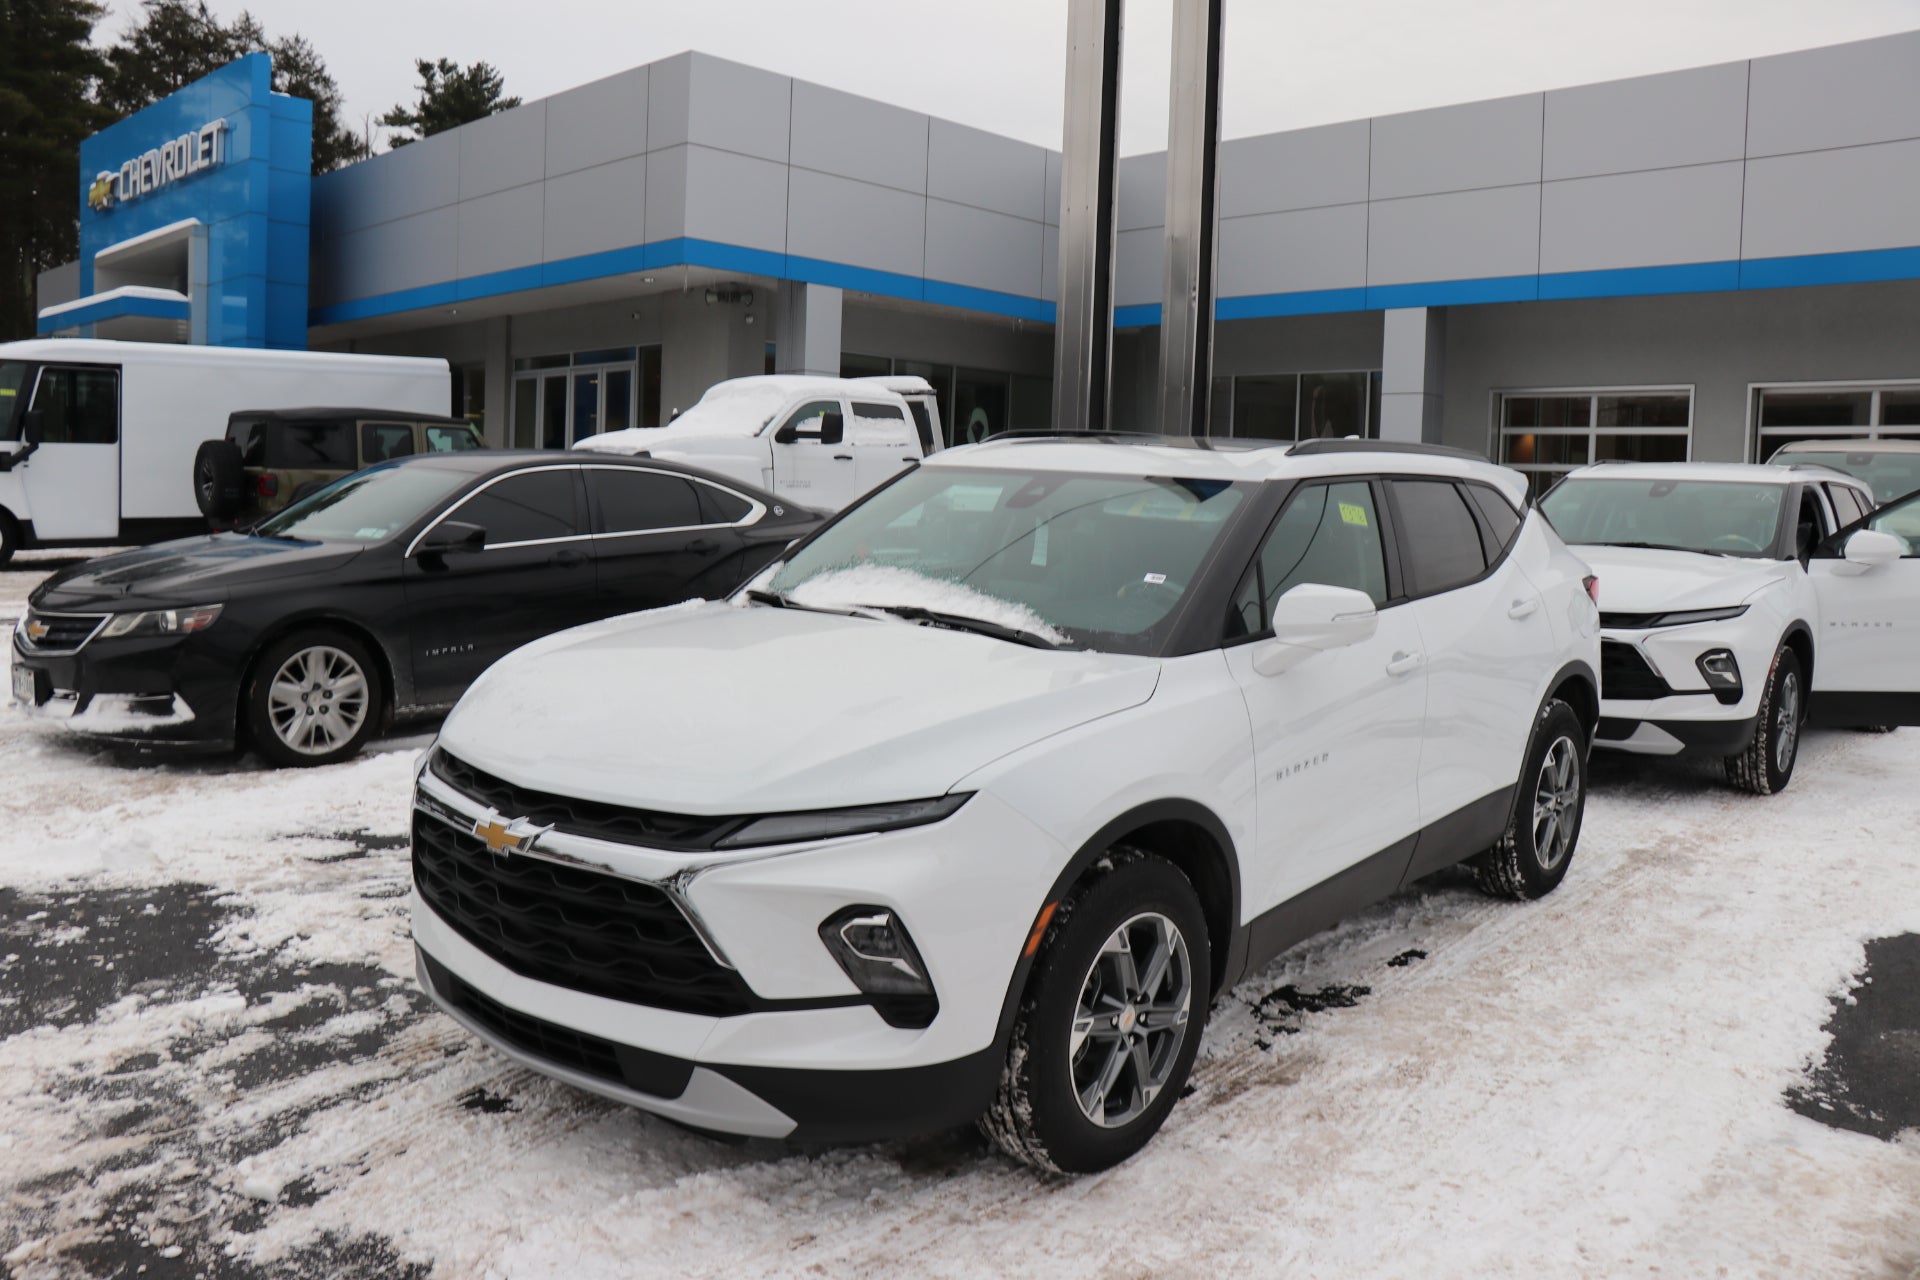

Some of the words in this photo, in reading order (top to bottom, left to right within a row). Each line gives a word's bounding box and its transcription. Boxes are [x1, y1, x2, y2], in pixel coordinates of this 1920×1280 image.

[120, 118, 227, 202] CHEVROLET
[425, 643, 474, 657] IMPALA
[1276, 752, 1329, 781] BLAZER
